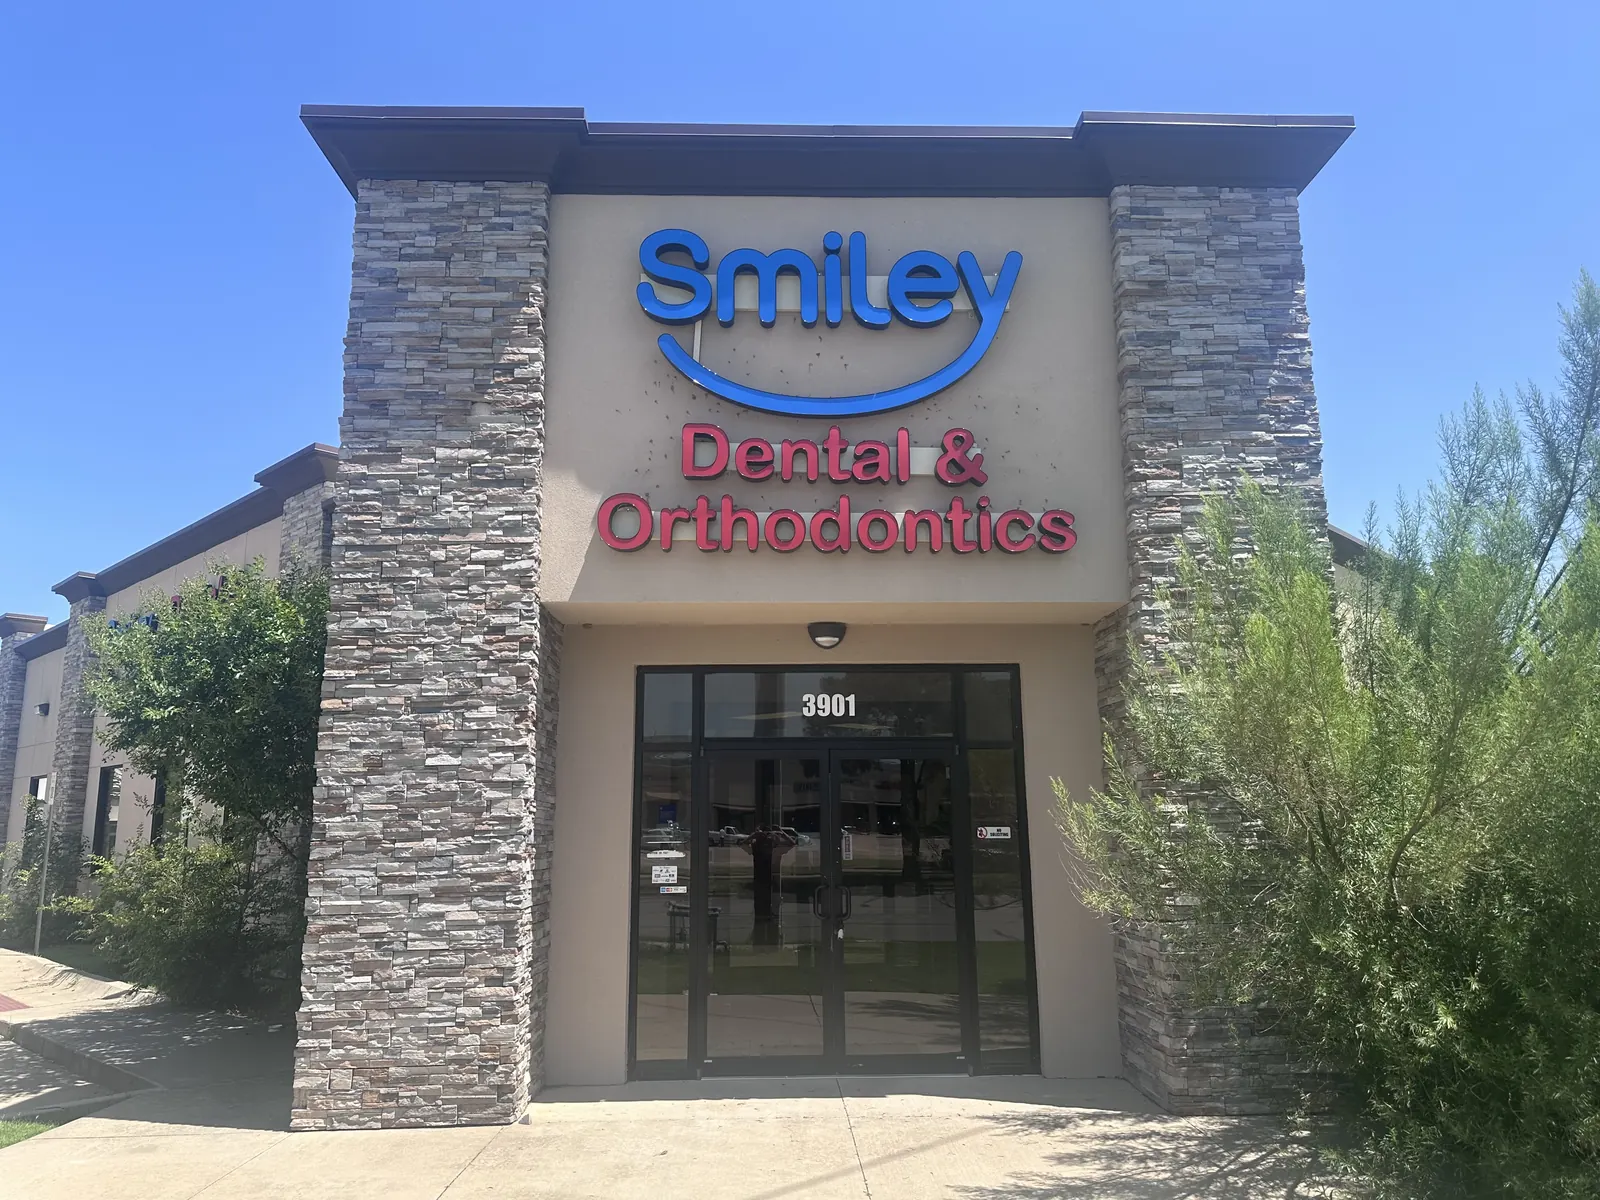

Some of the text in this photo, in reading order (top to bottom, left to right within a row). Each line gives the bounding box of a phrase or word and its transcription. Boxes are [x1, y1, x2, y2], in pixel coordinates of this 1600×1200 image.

[636, 228, 1023, 418] Smiley
[682, 423, 988, 487] Dental &
[597, 492, 1077, 553] Orthodontics
[802, 693, 855, 717] 3901
